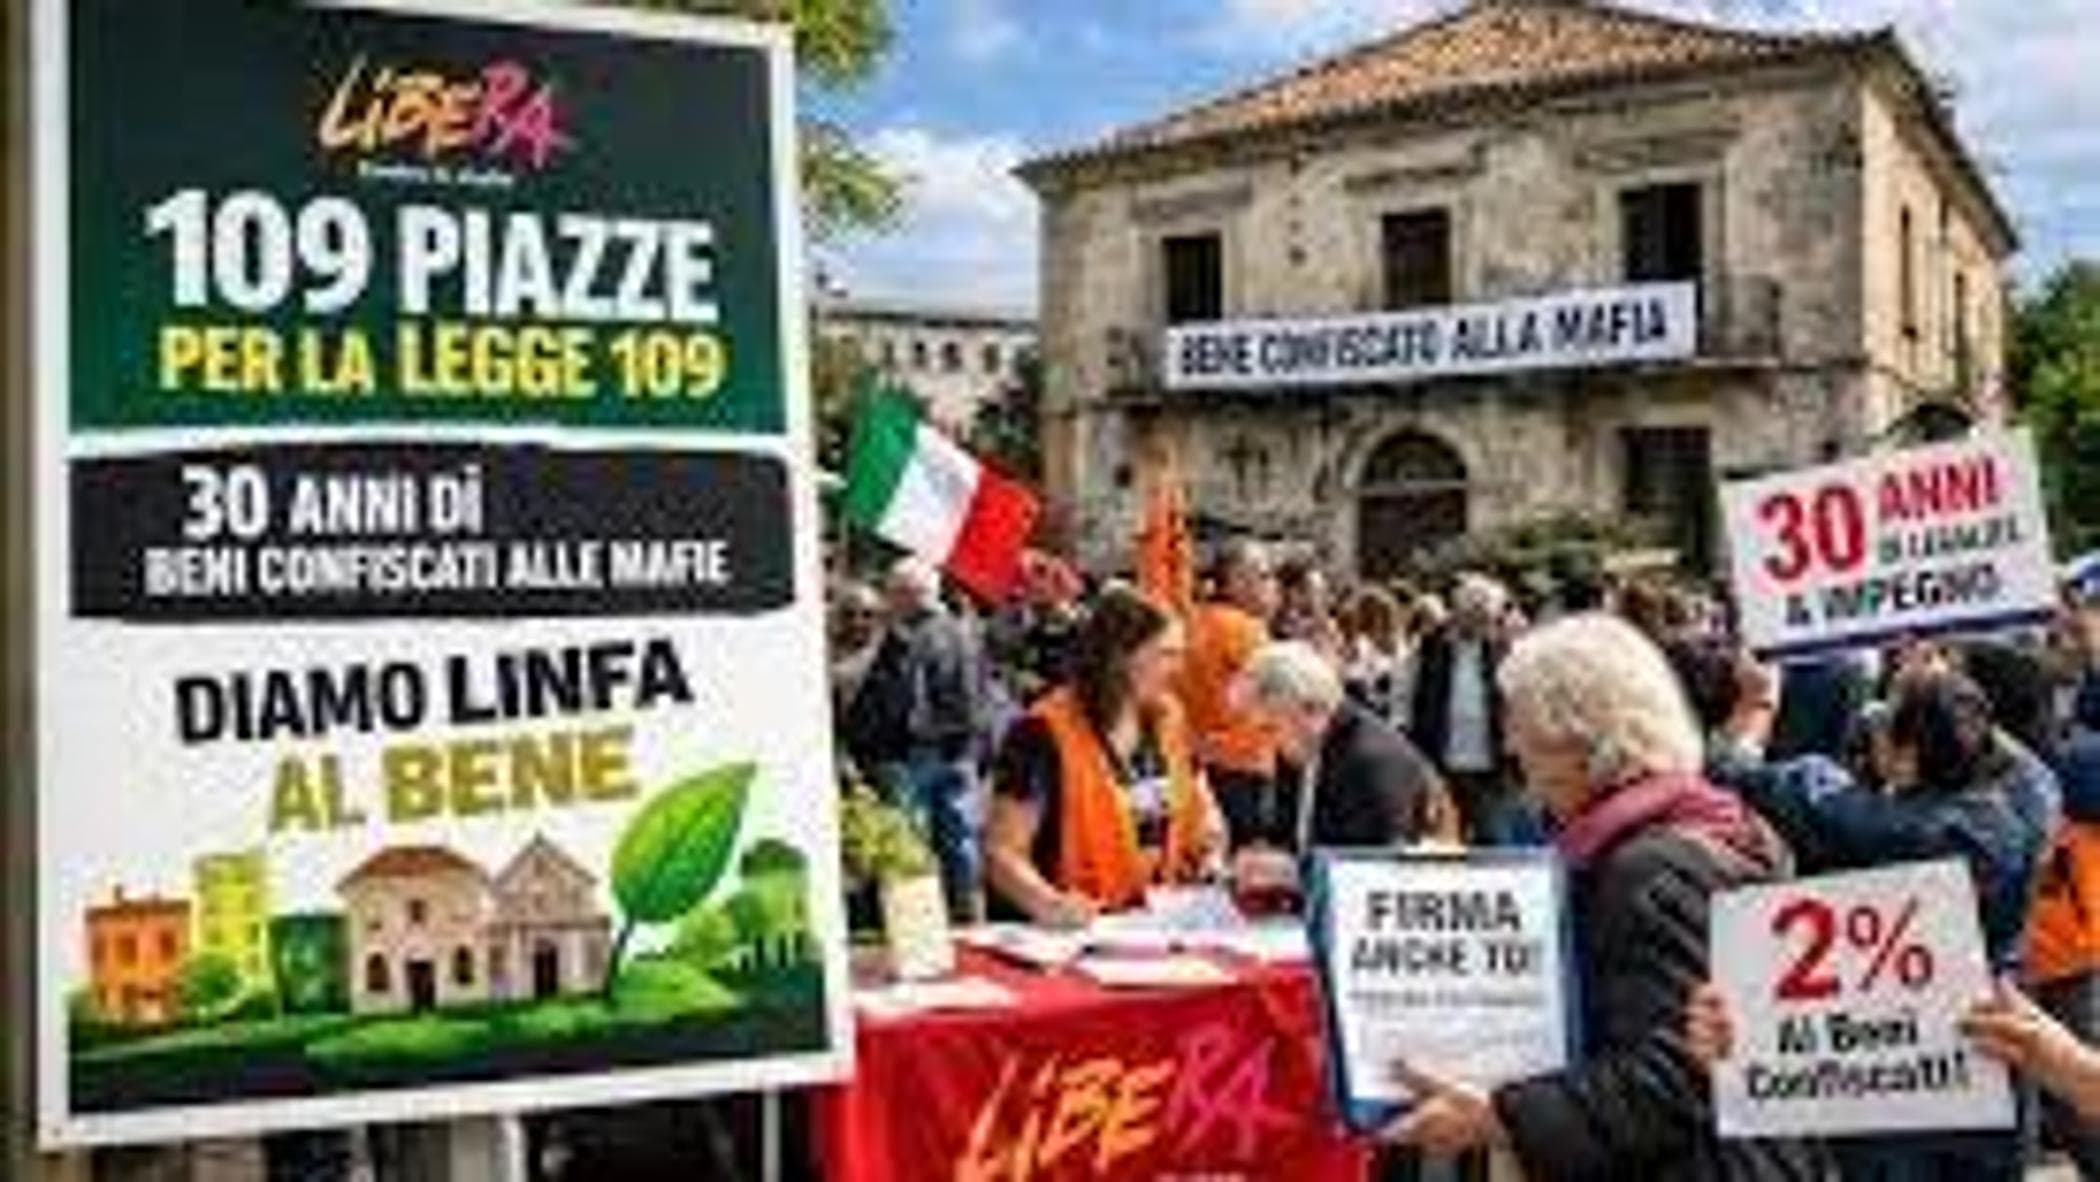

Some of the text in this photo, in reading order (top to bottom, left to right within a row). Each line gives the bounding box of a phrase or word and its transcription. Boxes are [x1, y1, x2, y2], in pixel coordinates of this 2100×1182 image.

[146, 191, 719, 321] 109 PIAZZE
[160, 323, 727, 399] PER LA LEGGE 109
[1183, 299, 1665, 376] BENE CONFISCATO ALLA MAFIA
[183, 465, 269, 539] 30
[1758, 483, 1866, 581] 30
[1879, 459, 1996, 518] ANNI
[144, 540, 731, 597] BENI CONFISCATI ALLE MAFIE
[176, 640, 692, 744] DIAMO LINFA
[271, 727, 638, 831] AL BENE
[1366, 890, 1522, 932] FIRMA
[1772, 895, 1934, 1000] 2%
[1351, 936, 1470, 977] ANCHE
